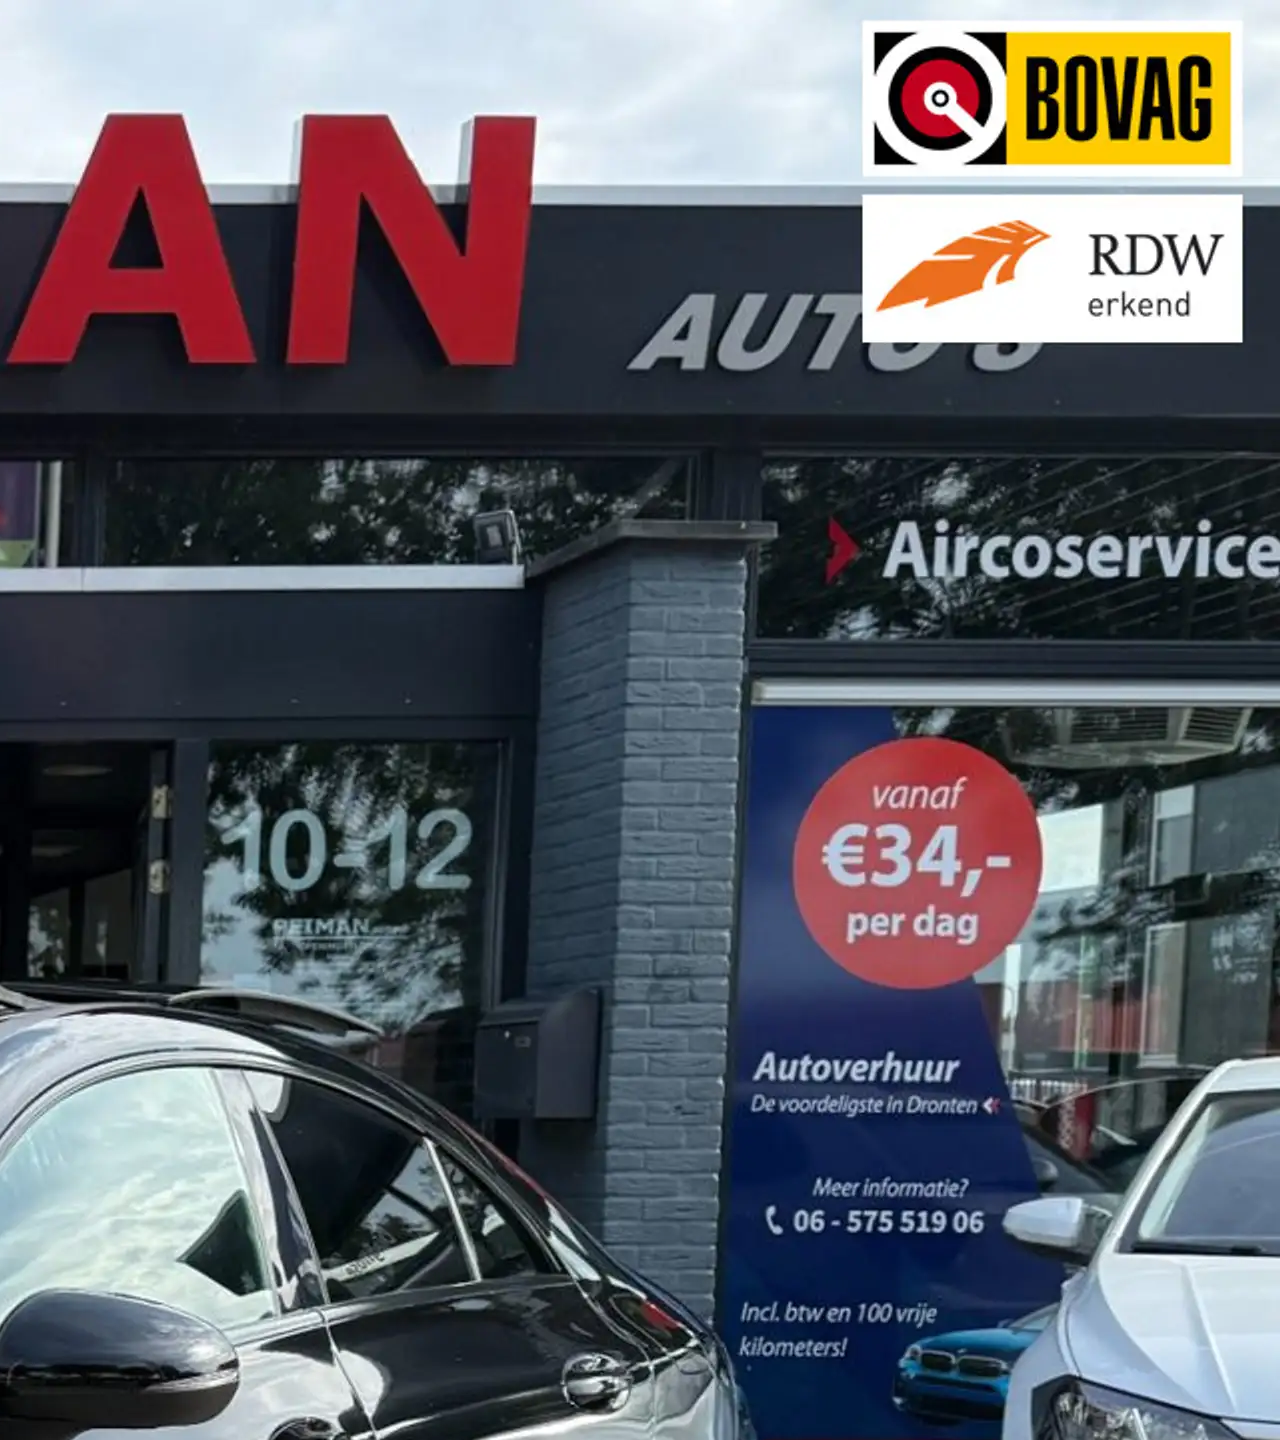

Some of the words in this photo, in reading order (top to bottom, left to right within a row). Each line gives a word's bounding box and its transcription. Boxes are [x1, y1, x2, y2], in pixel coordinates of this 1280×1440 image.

[882, 518, 1280, 579] Aircoservice
[871, 777, 967, 810] vanaf
[221, 808, 473, 891] 10-12
[822, 823, 1011, 897] €34,-
[846, 911, 906, 943] per
[913, 905, 979, 944] dag
[752, 1051, 960, 1083] Autoverhuur
[750, 1094, 775, 1113] De
[778, 1094, 883, 1117] voordeligste
[886, 1096, 904, 1114] in
[907, 1095, 978, 1114] Dronten
[812, 1177, 861, 1198] Meer
[863, 1176, 969, 1198] informatie?
[793, 1209, 825, 1233] 06
[847, 1210, 894, 1233] 575
[899, 1210, 947, 1233] 519
[953, 1210, 985, 1234] 06
[740, 1301, 779, 1323] Incl.
[784, 1302, 824, 1323] btw
[827, 1306, 851, 1323] en
[858, 1303, 893, 1323] 100
[896, 1303, 938, 1328] vrije
[739, 1336, 848, 1357] kilometers!
